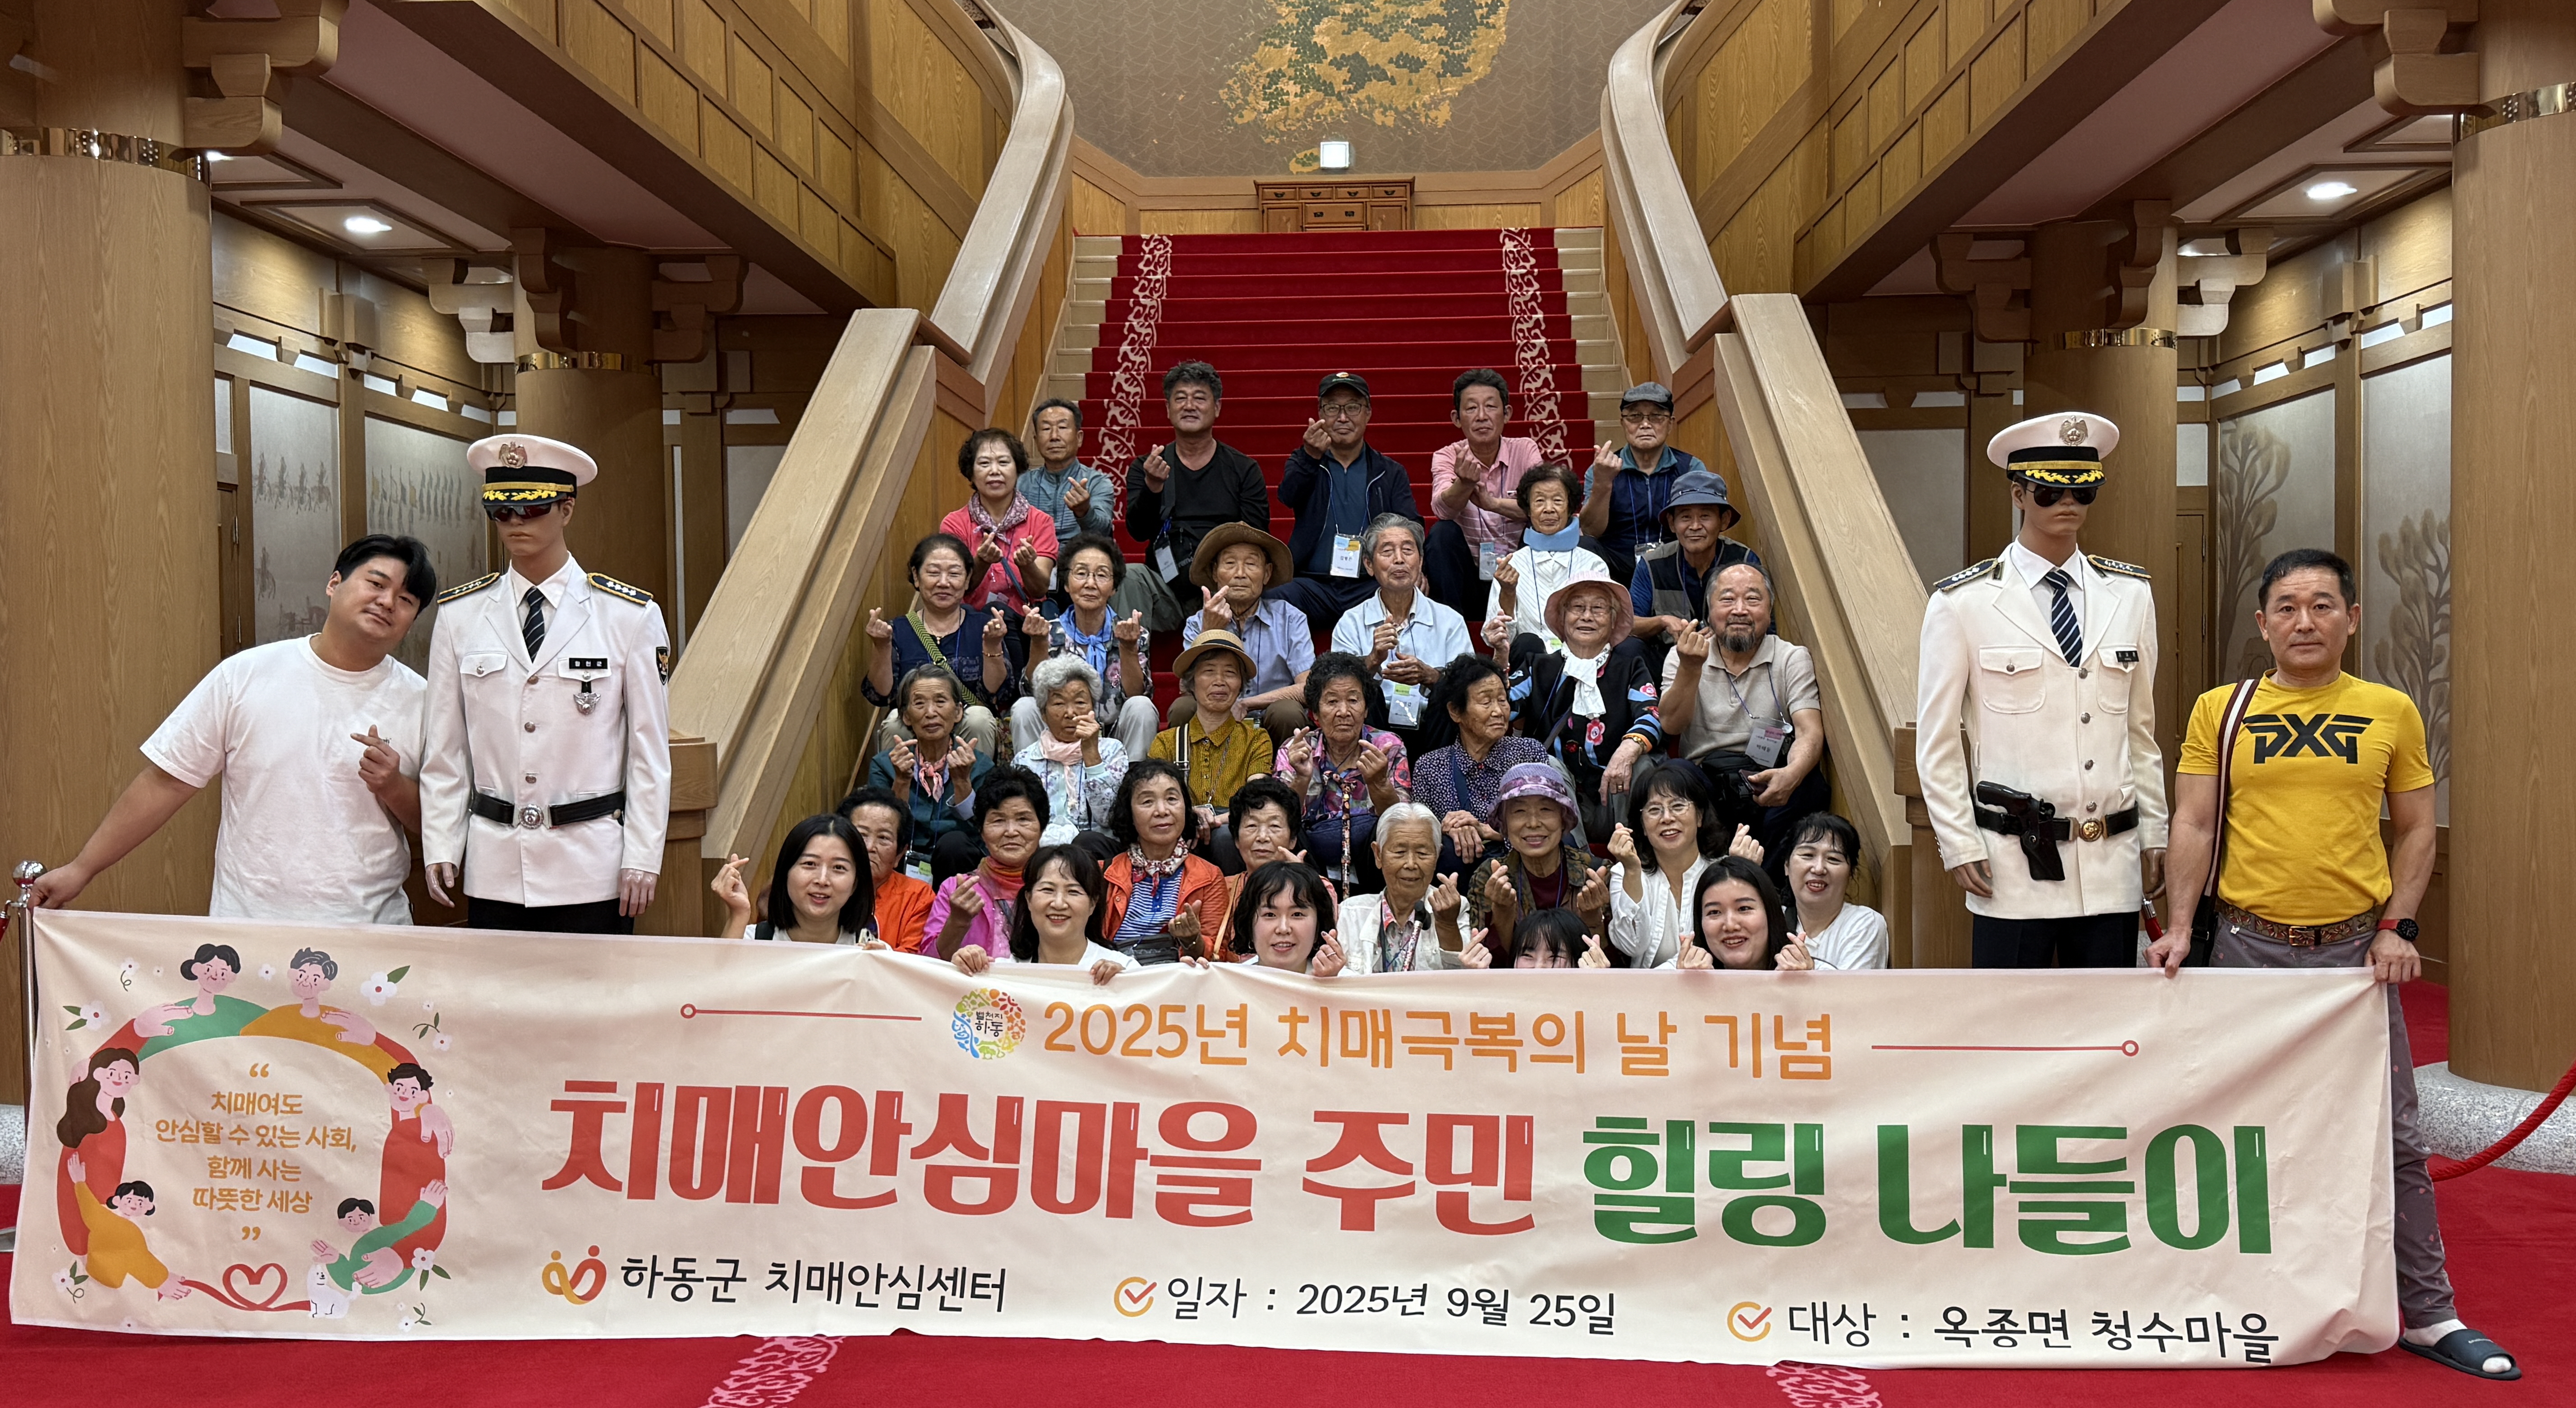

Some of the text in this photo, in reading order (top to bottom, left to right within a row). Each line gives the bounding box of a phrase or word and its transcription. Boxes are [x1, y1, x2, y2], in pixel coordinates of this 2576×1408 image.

[2243, 714, 2374, 764] PXG
[975, 1020, 1003, 1037] 하동
[1044, 1002, 1832, 1080] 2025년 치매극복의 날 기념
[212, 1092, 303, 1116] 치매여도
[156, 1119, 356, 1152] 안심할 수 있는 사회,
[207, 1155, 301, 1182] 함께 사는
[542, 1080, 2271, 1256] 치매안심마을 주민 힐링 나들이
[193, 1187, 313, 1214] 따뜻한 세상
[621, 1254, 1006, 1313] 하동군 치매안심센터
[1168, 1276, 1247, 1320] 일자
[1296, 1283, 1428, 1316] 2025년
[1446, 1288, 1509, 1327] 9월
[1529, 1293, 1615, 1336] 25일
[1789, 1301, 1877, 1348] 대상
[1934, 1306, 2072, 1348] 옥종면
[2091, 1311, 2279, 1364] 청수마을
